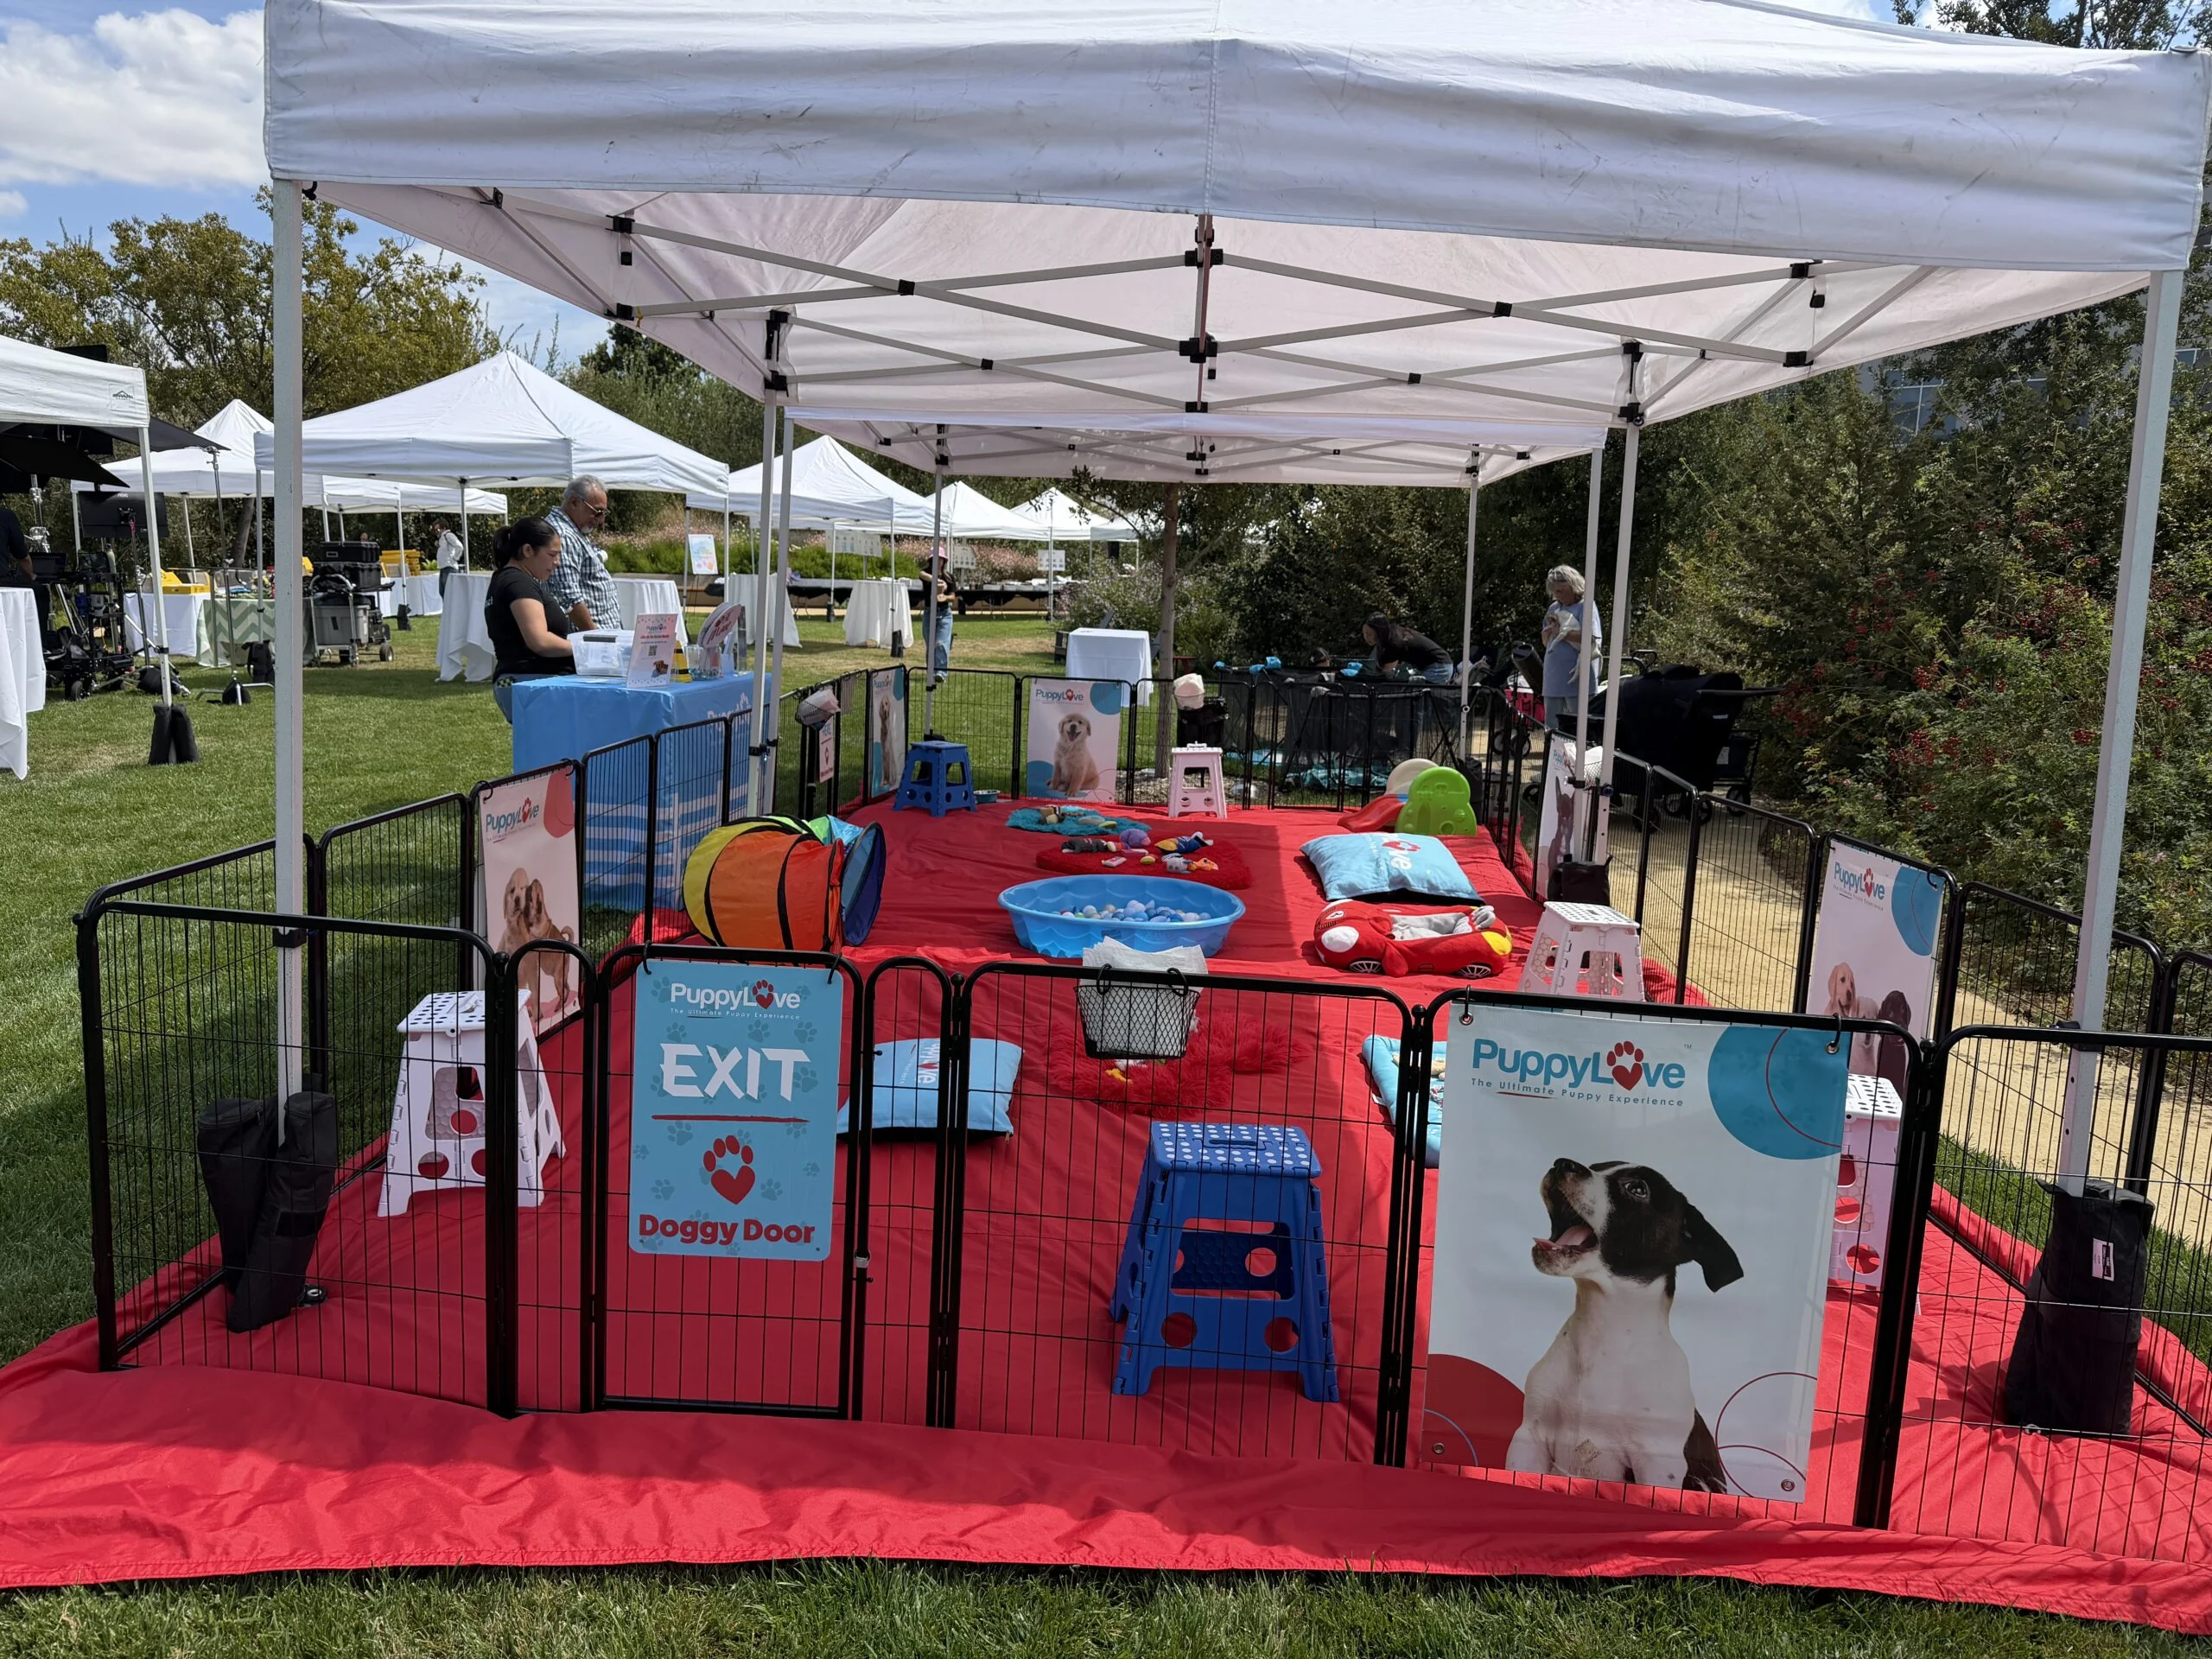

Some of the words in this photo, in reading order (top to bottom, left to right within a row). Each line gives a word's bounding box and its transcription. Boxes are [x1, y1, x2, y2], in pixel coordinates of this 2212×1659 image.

[1036, 689, 1084, 702] PuppyLove
[486, 797, 540, 834] PuppyLove
[1834, 861, 1885, 900] PuppyLove
[671, 979, 801, 1010] PuppyLove
[754, 1012, 800, 1020] Experience
[659, 1043, 811, 1103] EXIT
[1472, 1038, 1686, 1091] PuppyLove
[1471, 1077, 1493, 1088] The
[1499, 1081, 1555, 1095] Ultimate
[1561, 1089, 1602, 1103] Puppy
[1609, 1094, 1684, 1107] Experience
[639, 1214, 738, 1245] Doggy
[742, 1218, 816, 1244] Door
